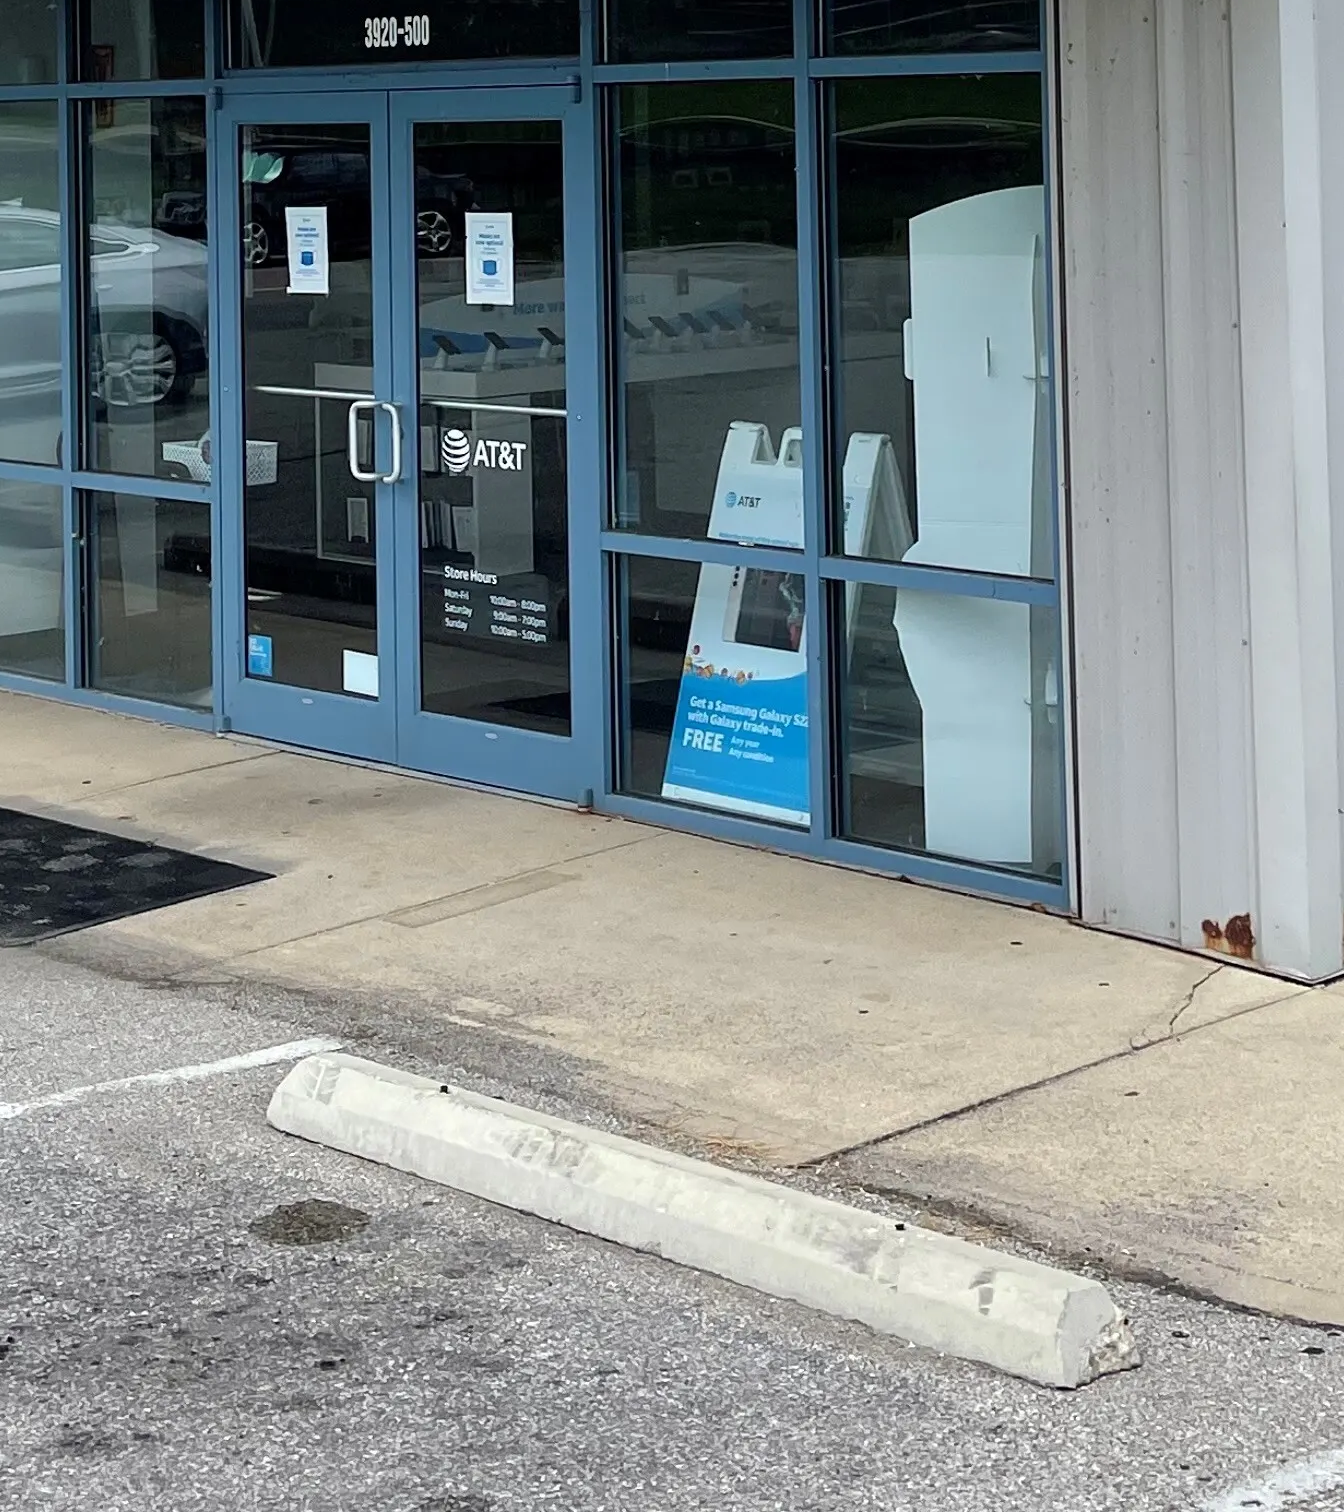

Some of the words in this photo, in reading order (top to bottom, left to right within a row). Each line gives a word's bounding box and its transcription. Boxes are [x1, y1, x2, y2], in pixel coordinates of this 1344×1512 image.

[365, 15, 430, 48] 3920-500
[473, 439, 527, 471] AT&T
[737, 495, 761, 509] AT&T
[444, 565, 469, 581] Store
[470, 569, 498, 585] Hours
[445, 602, 473, 618] Saturday
[445, 617, 468, 632] Sunday
[687, 710, 709, 724] with
[709, 713, 742, 732] Galaxy
[743, 720, 784, 738] trade-in.
[690, 695, 707, 709] Get
[707, 700, 714, 710] a
[714, 700, 758, 721] Samsung
[759, 707, 793, 728] Galaxy
[682, 727, 724, 753] FREE
